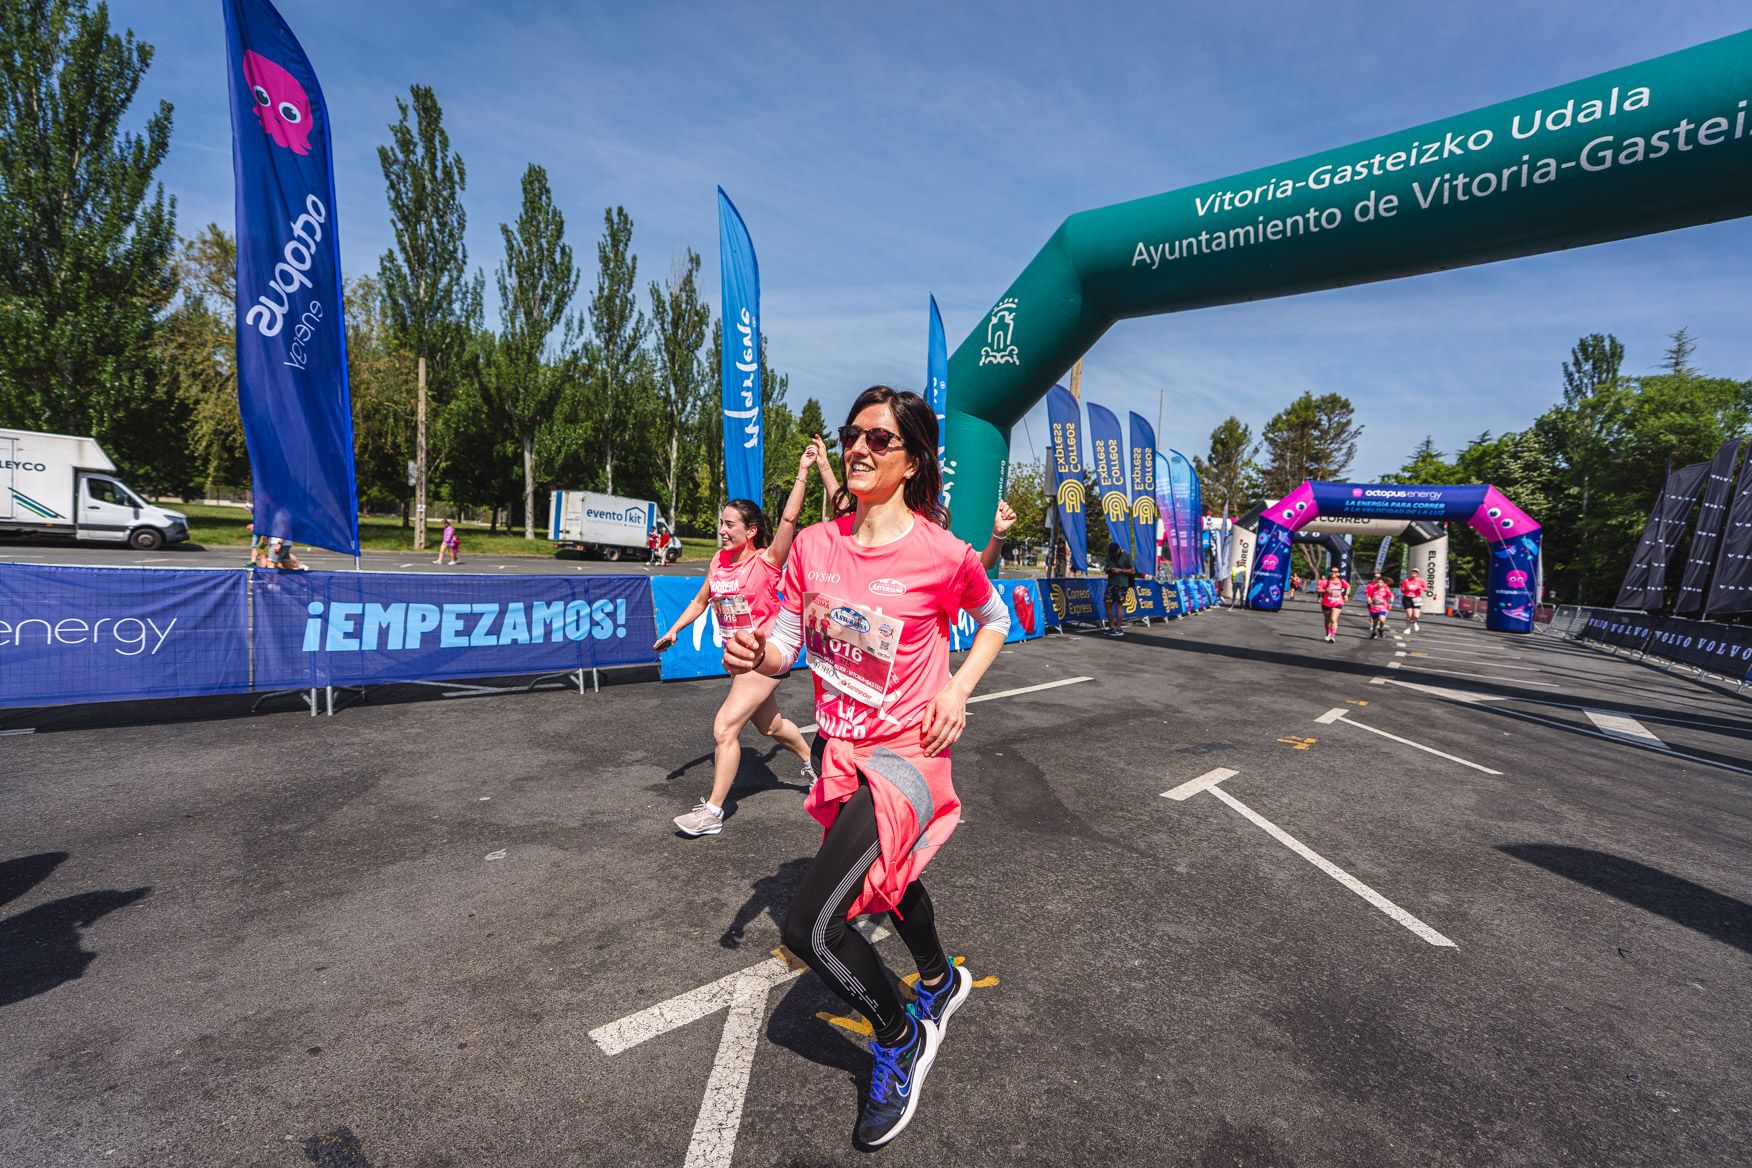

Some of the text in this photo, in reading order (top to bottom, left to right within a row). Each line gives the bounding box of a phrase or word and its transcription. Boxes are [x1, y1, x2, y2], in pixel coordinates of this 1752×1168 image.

[1194, 86, 1651, 218] Vitoria-Gasteizko Udala
[1131, 99, 1752, 271] Ayuntamiento de Vitoria-Gastei
[586, 508, 623, 521] evento
[628, 513, 641, 524] kit
[1428, 550, 1437, 561] EL
[807, 570, 841, 584] OYSHO
[1067, 587, 1090, 600] Correos
[1068, 602, 1092, 616] Express
[302, 598, 627, 652] ¡EMPEZAMOS!
[1610, 623, 1648, 638] VOLVO
[1654, 630, 1692, 648] VOLVO
[829, 639, 863, 663] 016
[1697, 637, 1752, 660] VOLVO
